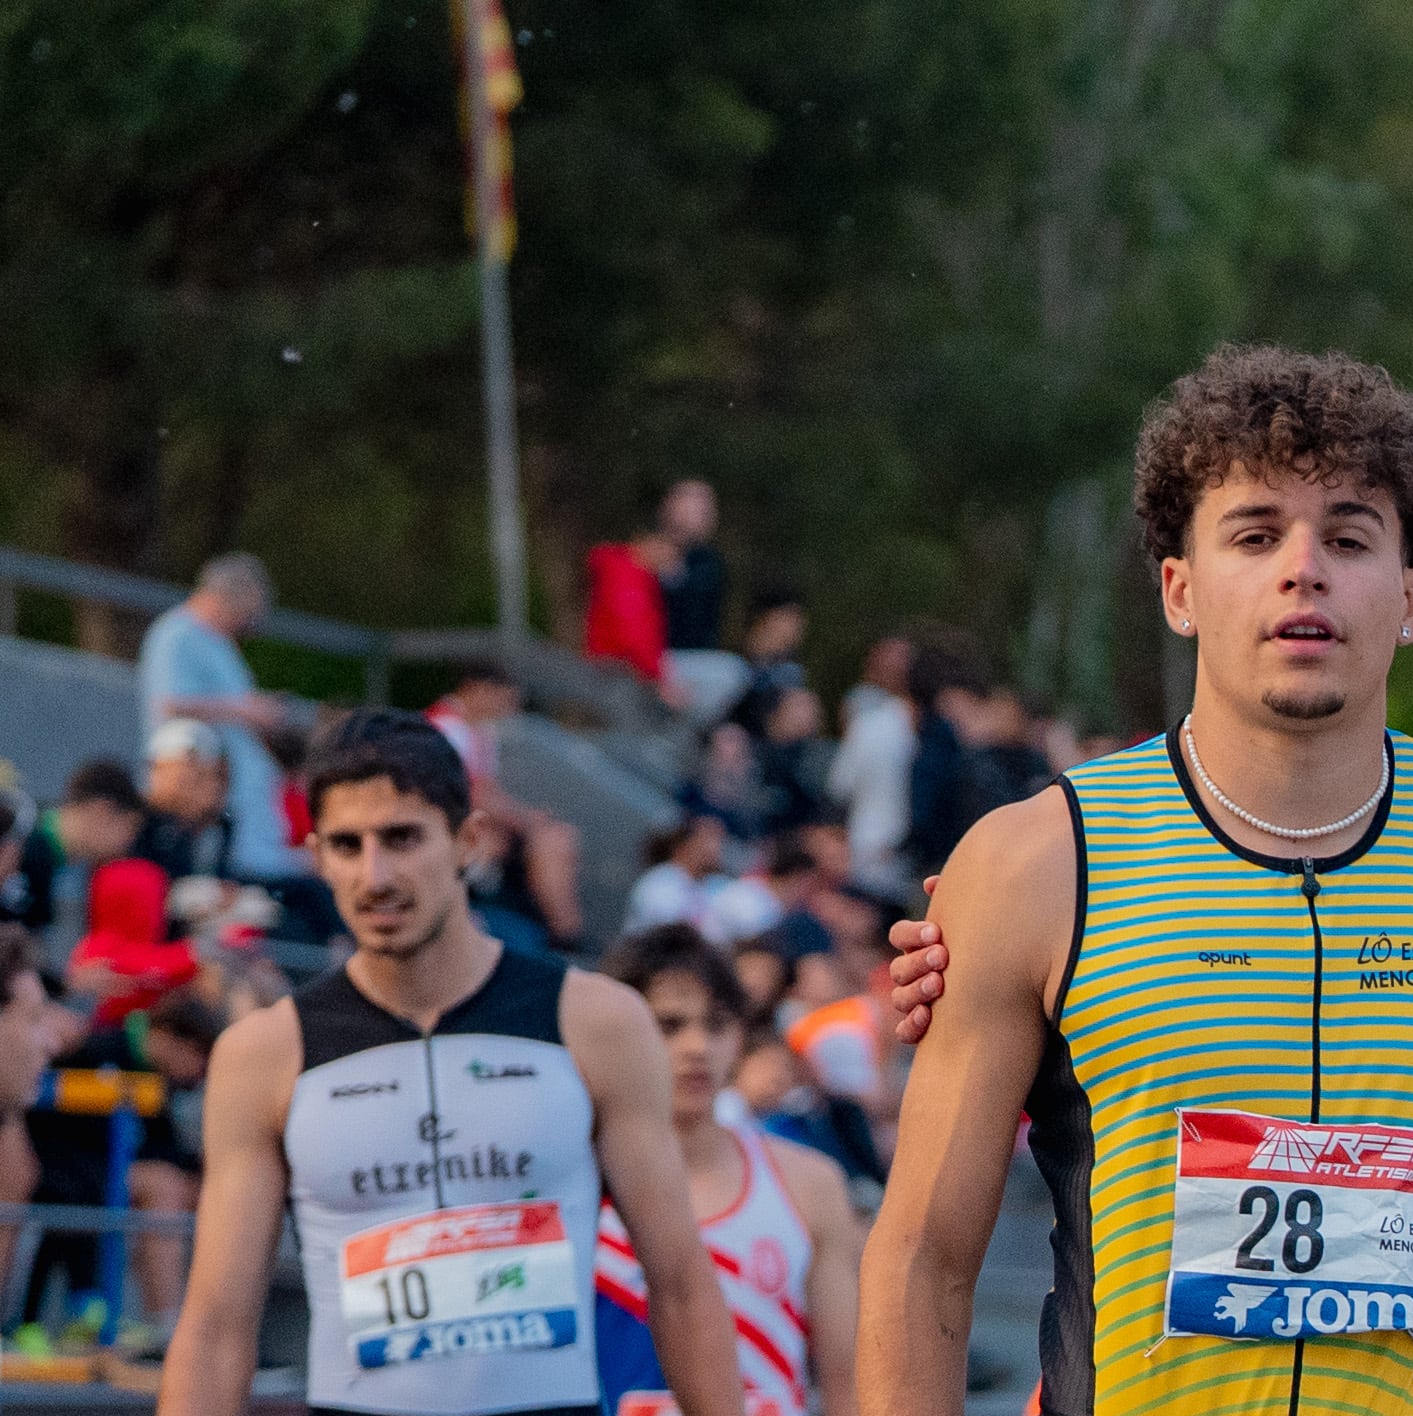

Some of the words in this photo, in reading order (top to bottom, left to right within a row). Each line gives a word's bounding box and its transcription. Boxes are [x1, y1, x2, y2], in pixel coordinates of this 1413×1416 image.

[1199, 950, 1252, 968] apunt
[1234, 1185, 1325, 1275] 28
[378, 1268, 429, 1325] 10
